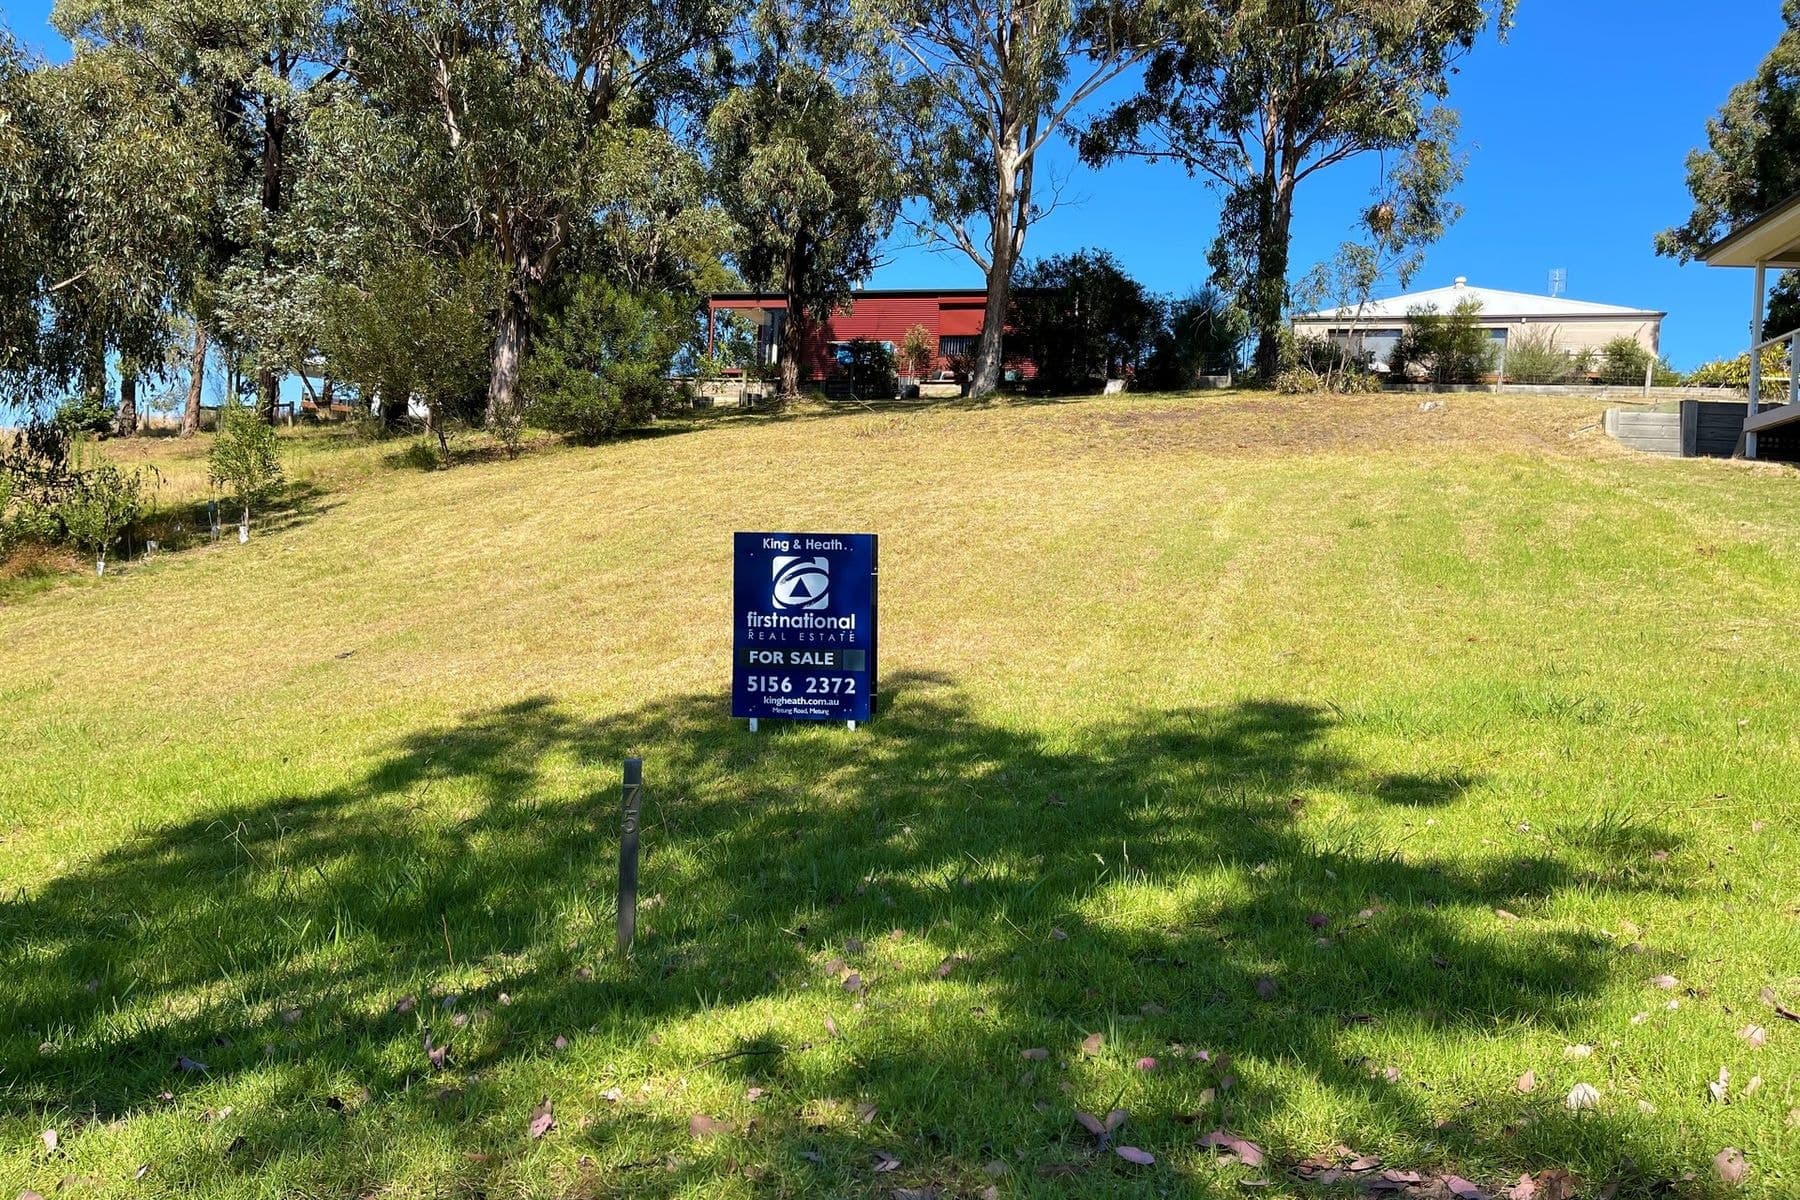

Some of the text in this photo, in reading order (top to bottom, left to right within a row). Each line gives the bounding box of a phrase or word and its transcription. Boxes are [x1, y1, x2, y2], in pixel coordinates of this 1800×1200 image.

[763, 538, 842, 552] King & Heath
[747, 612, 856, 630] firstnational
[748, 632, 855, 642] REAL ESTATE
[749, 651, 834, 665] FOR SALE
[747, 676, 856, 694] 5156 2372
[763, 696, 840, 708] kingheath.com.au
[621, 784, 640, 834] 75
